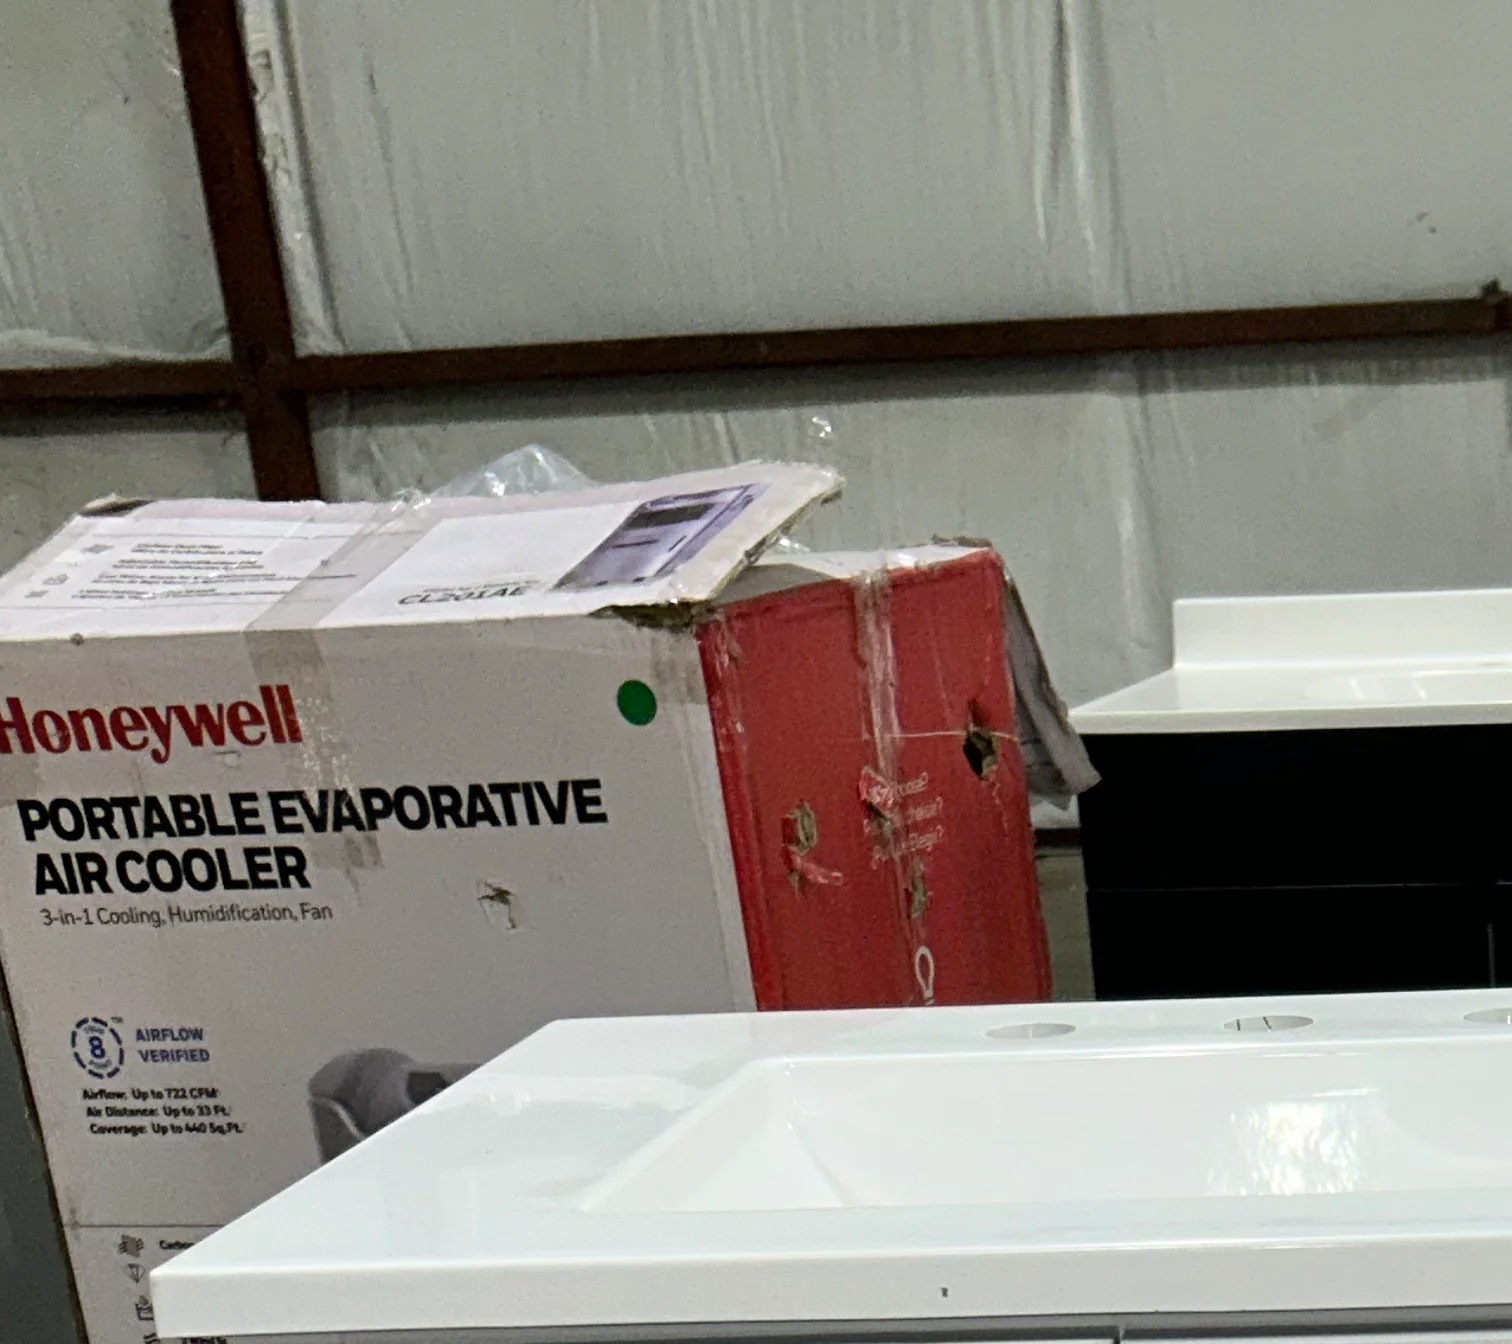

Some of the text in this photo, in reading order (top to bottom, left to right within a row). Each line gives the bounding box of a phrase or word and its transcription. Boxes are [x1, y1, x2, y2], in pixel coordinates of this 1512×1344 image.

[0, 684, 303, 764] Honeywell
[16, 778, 609, 842] PORTABLE EVAPORATIVE
[35, 845, 312, 896] AIR COOLER
[40, 902, 334, 928] 3-in-1 Cooling, Humidification, Fan
[135, 1027, 204, 1043] AIRFLOW
[88, 1035, 106, 1059] 8
[138, 1049, 211, 1064] VERIFIED
[131, 1087, 149, 1102] Up
[150, 1088, 165, 1100] to
[165, 1088, 188, 1100] 722
[86, 1106, 102, 1117] Air
[162, 1106, 180, 1119] Up
[181, 1106, 195, 1117] to
[151, 1123, 169, 1136] Up
[170, 1123, 184, 1135] to
